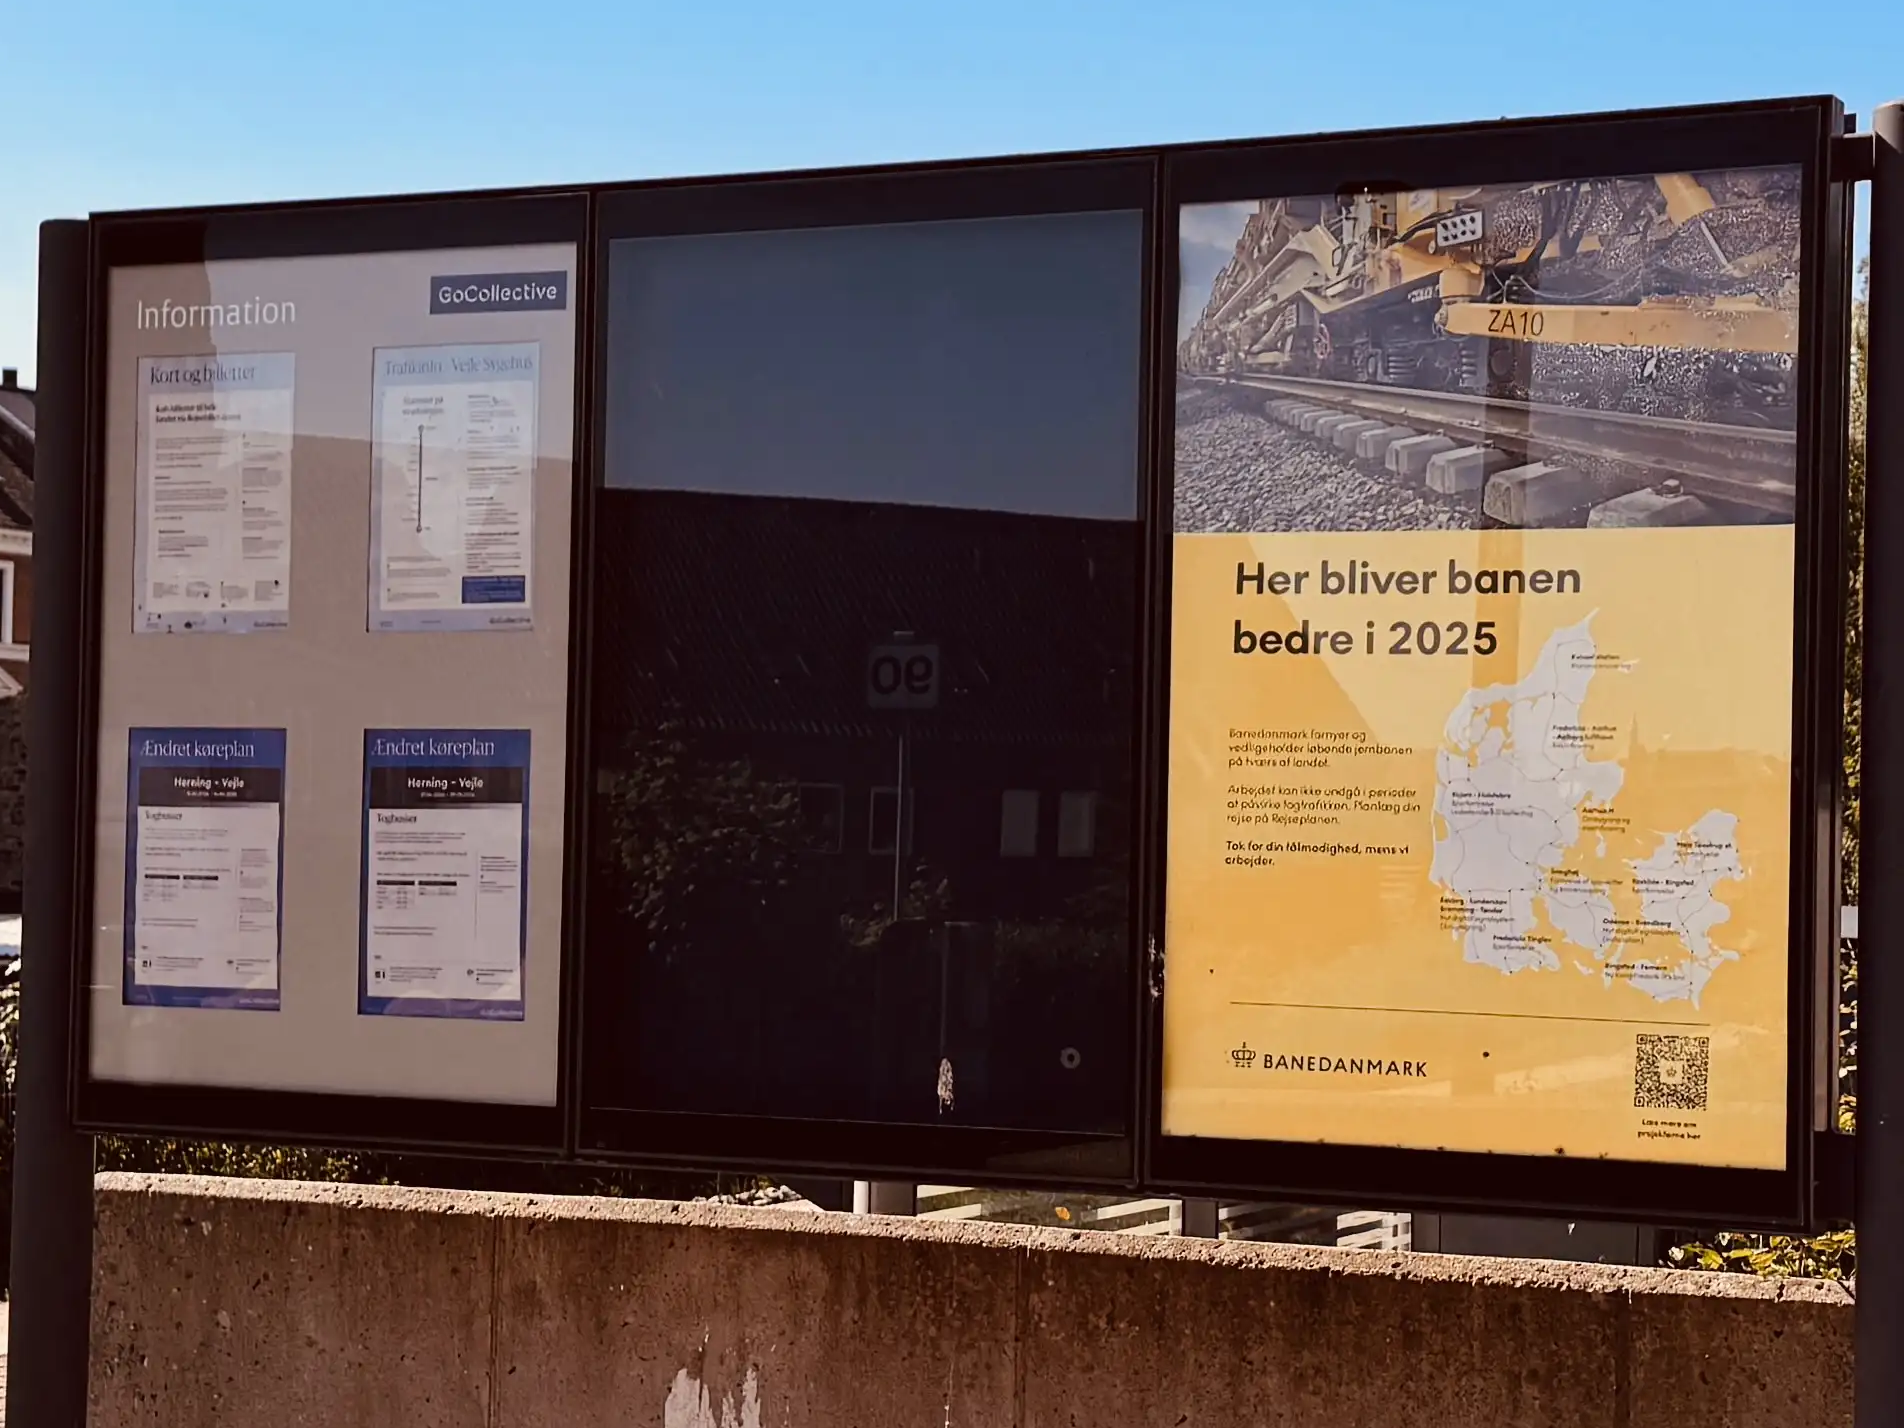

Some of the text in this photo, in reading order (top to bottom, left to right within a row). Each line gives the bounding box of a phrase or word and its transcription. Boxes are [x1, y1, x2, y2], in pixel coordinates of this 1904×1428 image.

[438, 282, 557, 304] GoCollective
[137, 295, 296, 330] Information
[1487, 309, 1545, 336] ZA10
[151, 360, 256, 386] Kort og billetter
[1235, 558, 1581, 596] Her bliver banen
[1232, 619, 1498, 656] bedre i 2025
[1228, 728, 1308, 740] Banedanmark
[1351, 731, 1367, 743] og
[139, 739, 256, 761] Ændret køreplan
[370, 737, 495, 760] Ændret køreplan
[1353, 744, 1413, 756] jernbanen
[1228, 756, 1243, 768] på
[1279, 757, 1291, 768] af
[174, 776, 212, 790] Herning
[221, 776, 245, 790] Vejle
[407, 776, 448, 791] Herning
[458, 776, 484, 791] Vejle
[1227, 784, 1276, 798] Arbejdet
[1277, 785, 1298, 796] kan
[1299, 785, 1322, 796] ikke
[1324, 786, 1361, 800] undgå
[1368, 788, 1417, 799] perioder
[1227, 798, 1239, 809] at
[1402, 803, 1421, 814] din
[1226, 814, 1253, 826] rejse
[1254, 814, 1269, 826] på
[1225, 840, 1245, 852] Tak
[1247, 841, 1264, 852] for
[1265, 841, 1284, 853] din
[1364, 845, 1397, 855] mens
[1398, 845, 1410, 855] vi
[1224, 855, 1276, 869] arbejder.
[1263, 1054, 1428, 1078] BANEDANMARK
